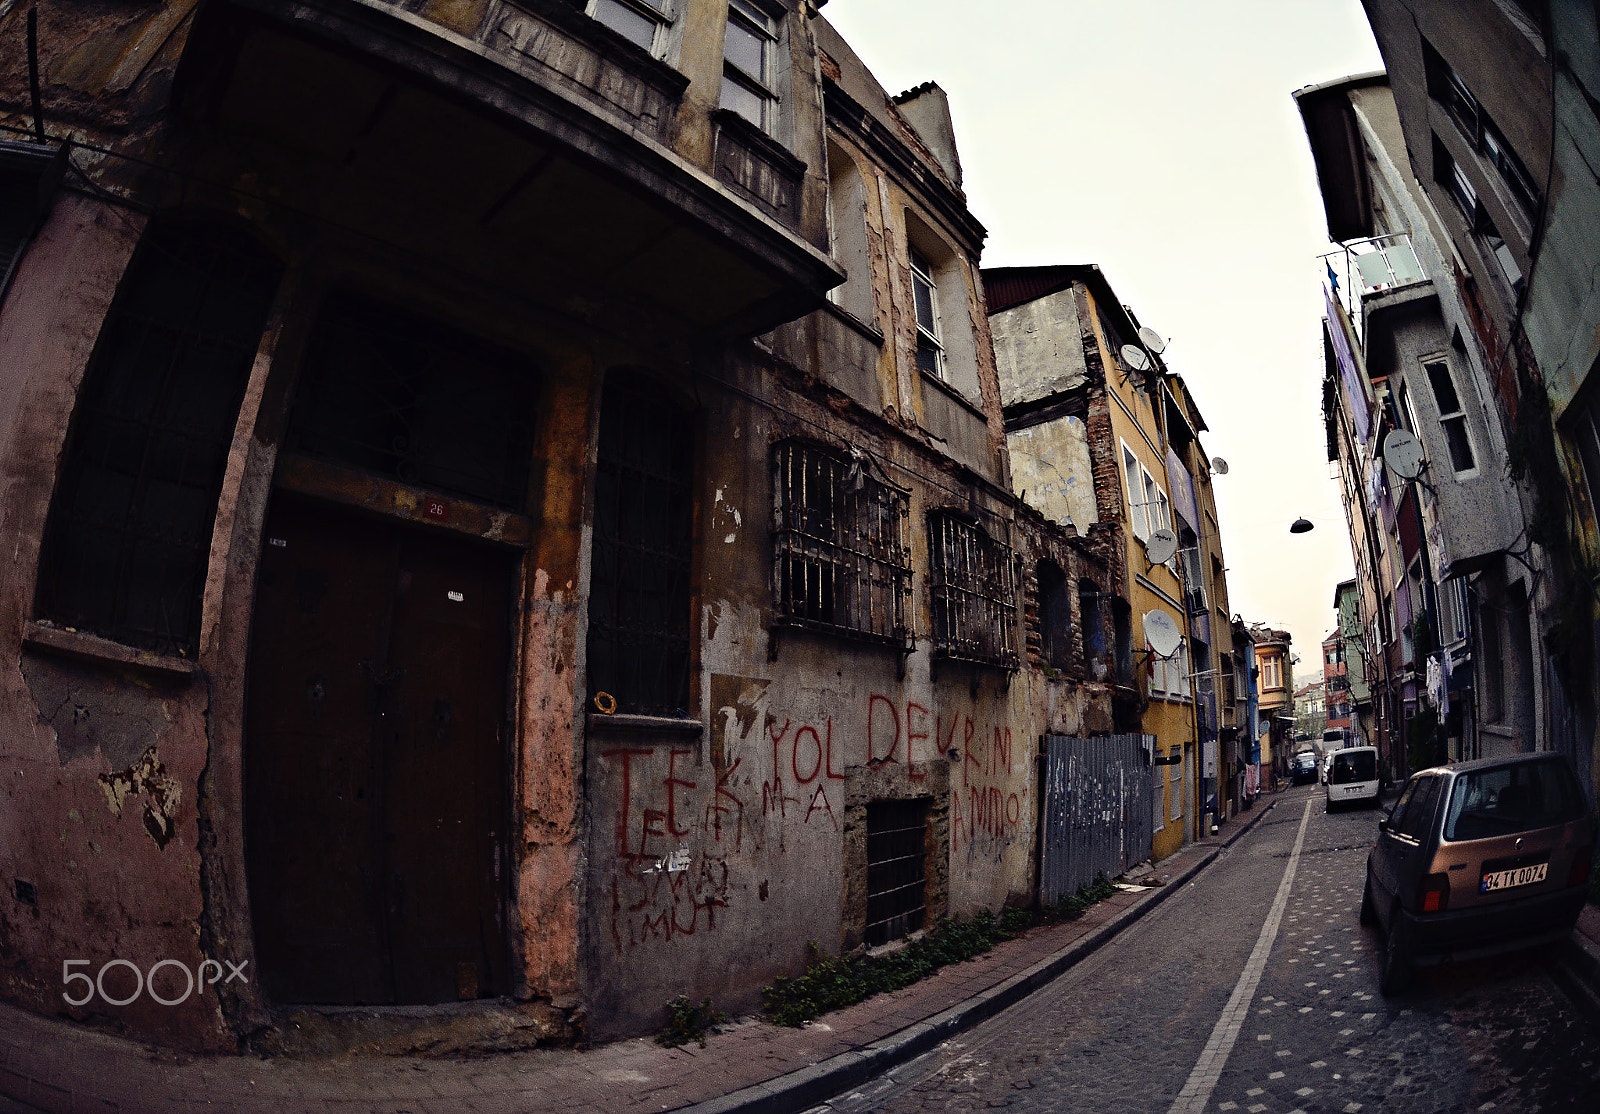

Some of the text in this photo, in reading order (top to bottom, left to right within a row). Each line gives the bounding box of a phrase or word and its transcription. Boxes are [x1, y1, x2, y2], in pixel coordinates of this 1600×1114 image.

[430, 503, 443, 515] 26
[765, 716, 845, 784] YOL
[1487, 865, 1545, 889] 34 TK 0074
